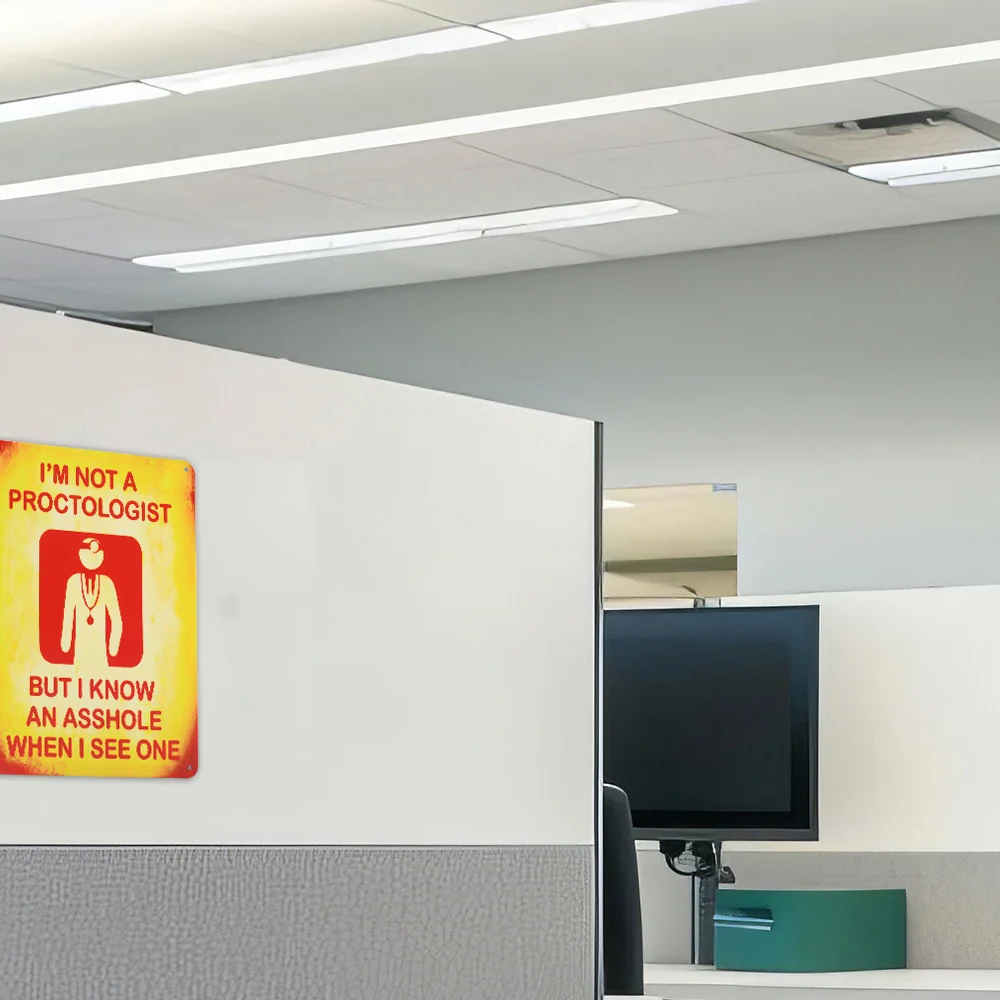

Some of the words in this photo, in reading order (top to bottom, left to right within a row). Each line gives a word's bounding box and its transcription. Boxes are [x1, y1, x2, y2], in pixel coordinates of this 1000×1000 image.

[40, 462, 69, 485] I'M
[75, 466, 118, 491] NOT
[122, 471, 138, 492] A
[8, 488, 172, 524] PROCTOLOGIST
[29, 675, 73, 699] BUT
[89, 678, 155, 702] KNOW
[26, 705, 57, 728] AN
[62, 707, 162, 731] ASSHOLE
[6, 735, 73, 759] WHEN
[90, 738, 131, 759] SEE
[136, 739, 181, 761] ONE
